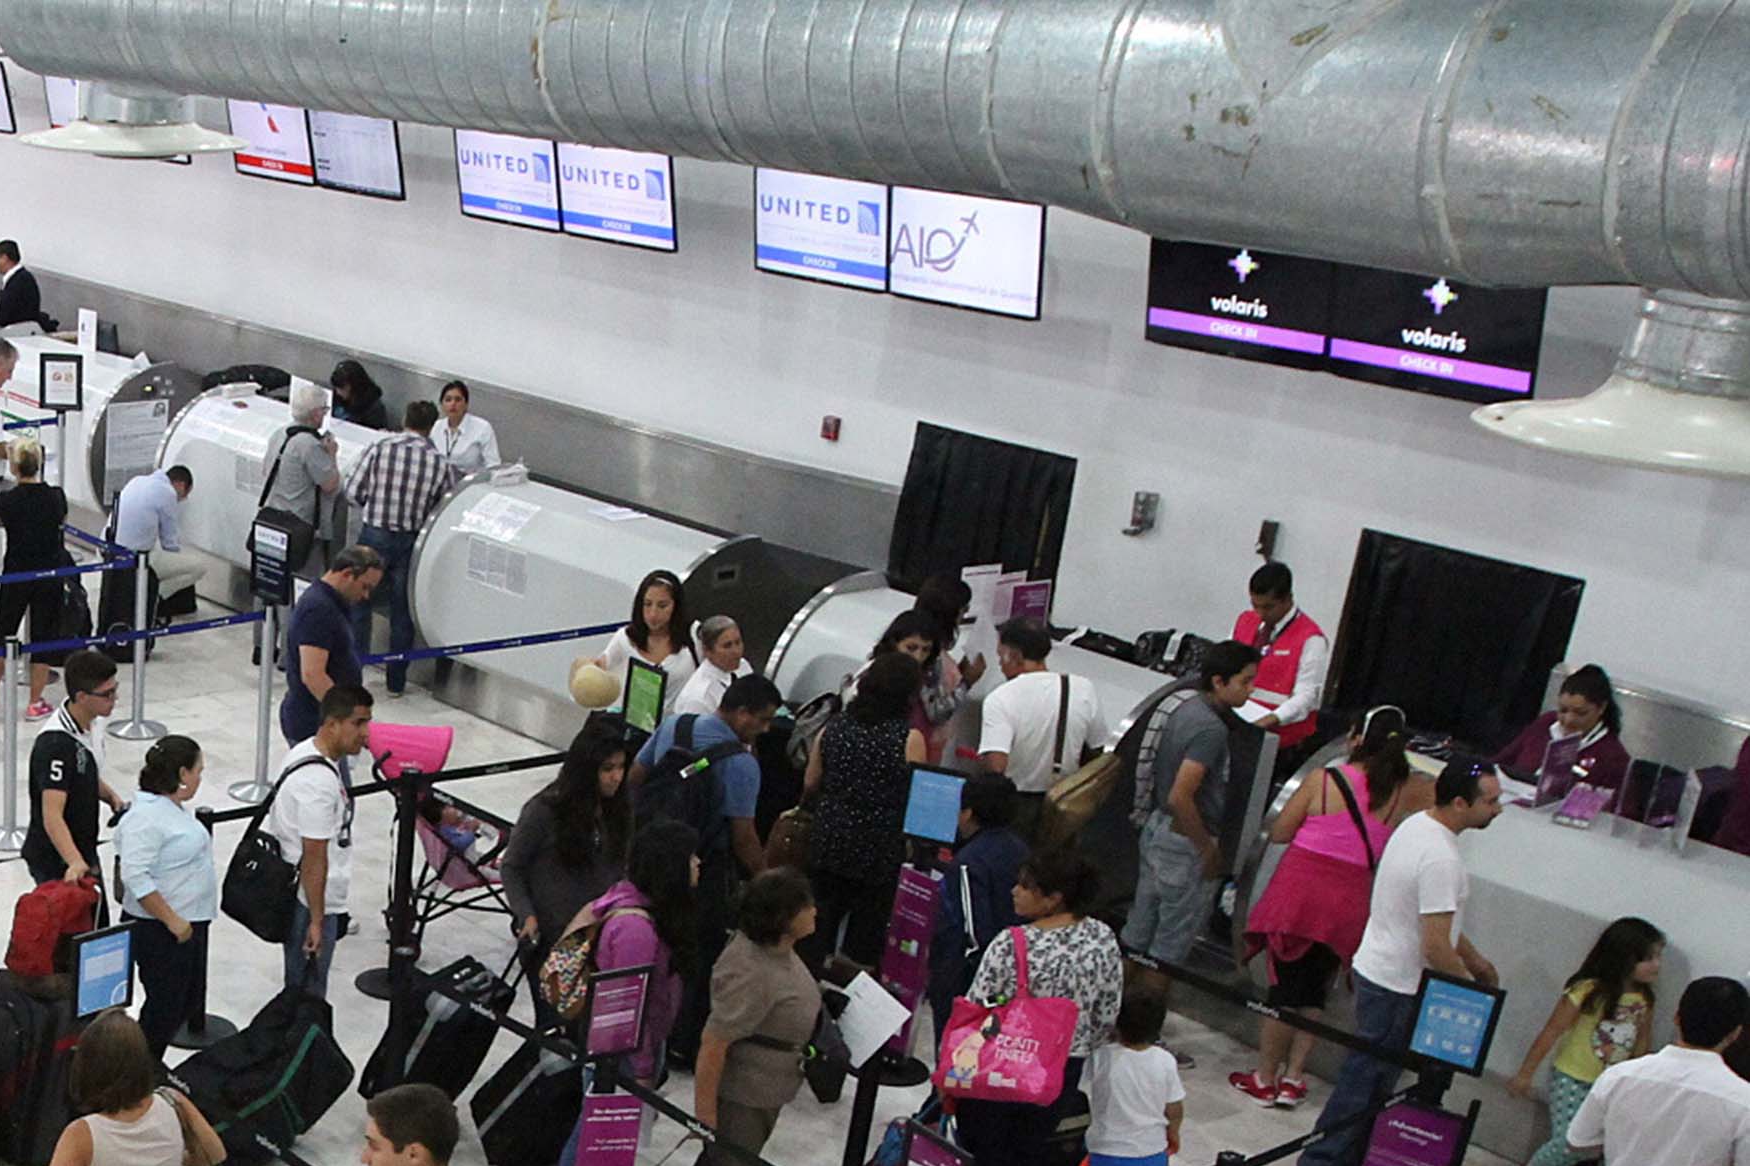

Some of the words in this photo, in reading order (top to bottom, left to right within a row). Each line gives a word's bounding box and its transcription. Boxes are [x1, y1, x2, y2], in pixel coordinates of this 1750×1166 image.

[461, 149, 528, 173] UNITED
[562, 164, 640, 190] UNITED
[761, 194, 850, 224] UNITED
[1211, 294, 1268, 318] volaris
[1210, 322, 1243, 337] CHECK
[1402, 326, 1467, 353] volaris
[1400, 354, 1437, 372] CHECK
[50, 760, 64, 781] 5
[1247, 1000, 1279, 1018] volaris
[687, 1119, 716, 1143] volaris
